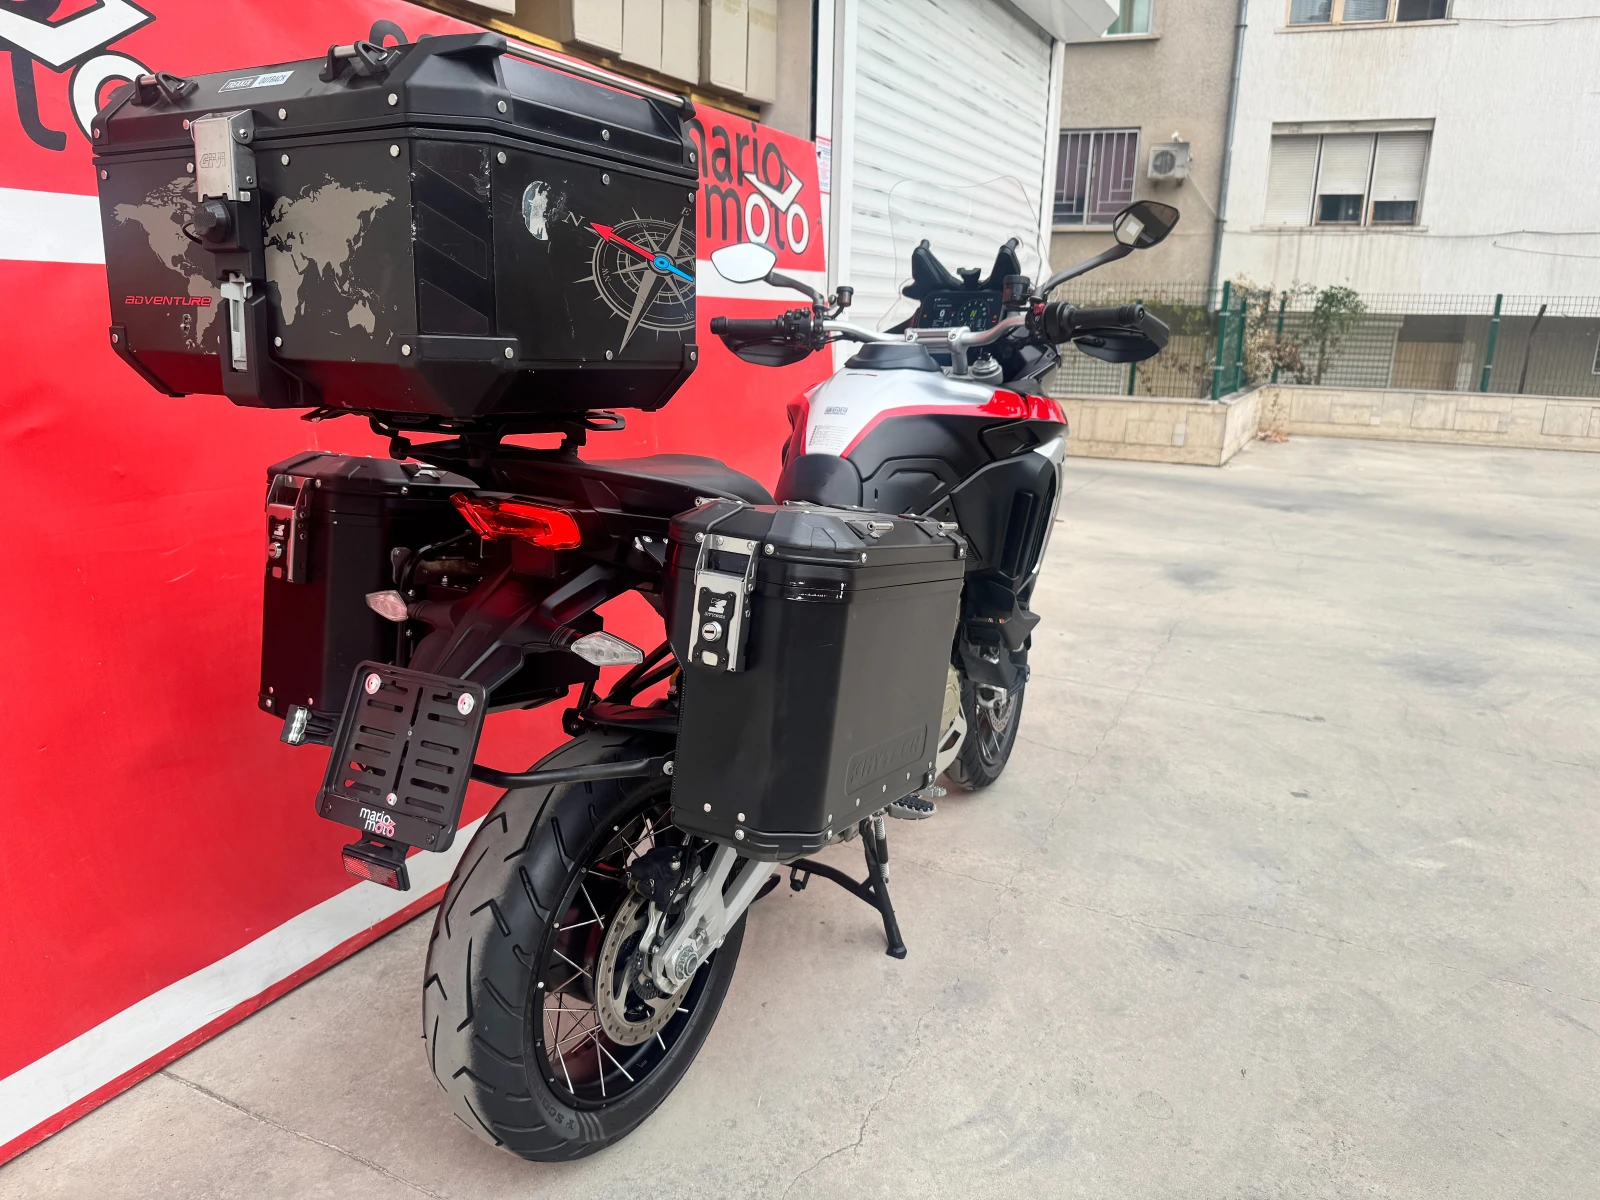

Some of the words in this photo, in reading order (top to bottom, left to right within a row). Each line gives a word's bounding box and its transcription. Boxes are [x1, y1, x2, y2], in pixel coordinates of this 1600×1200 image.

[561, 211, 585, 227] N
[705, 184, 810, 255] moto
[359, 807, 391, 824] mario
[364, 819, 395, 837] moto
